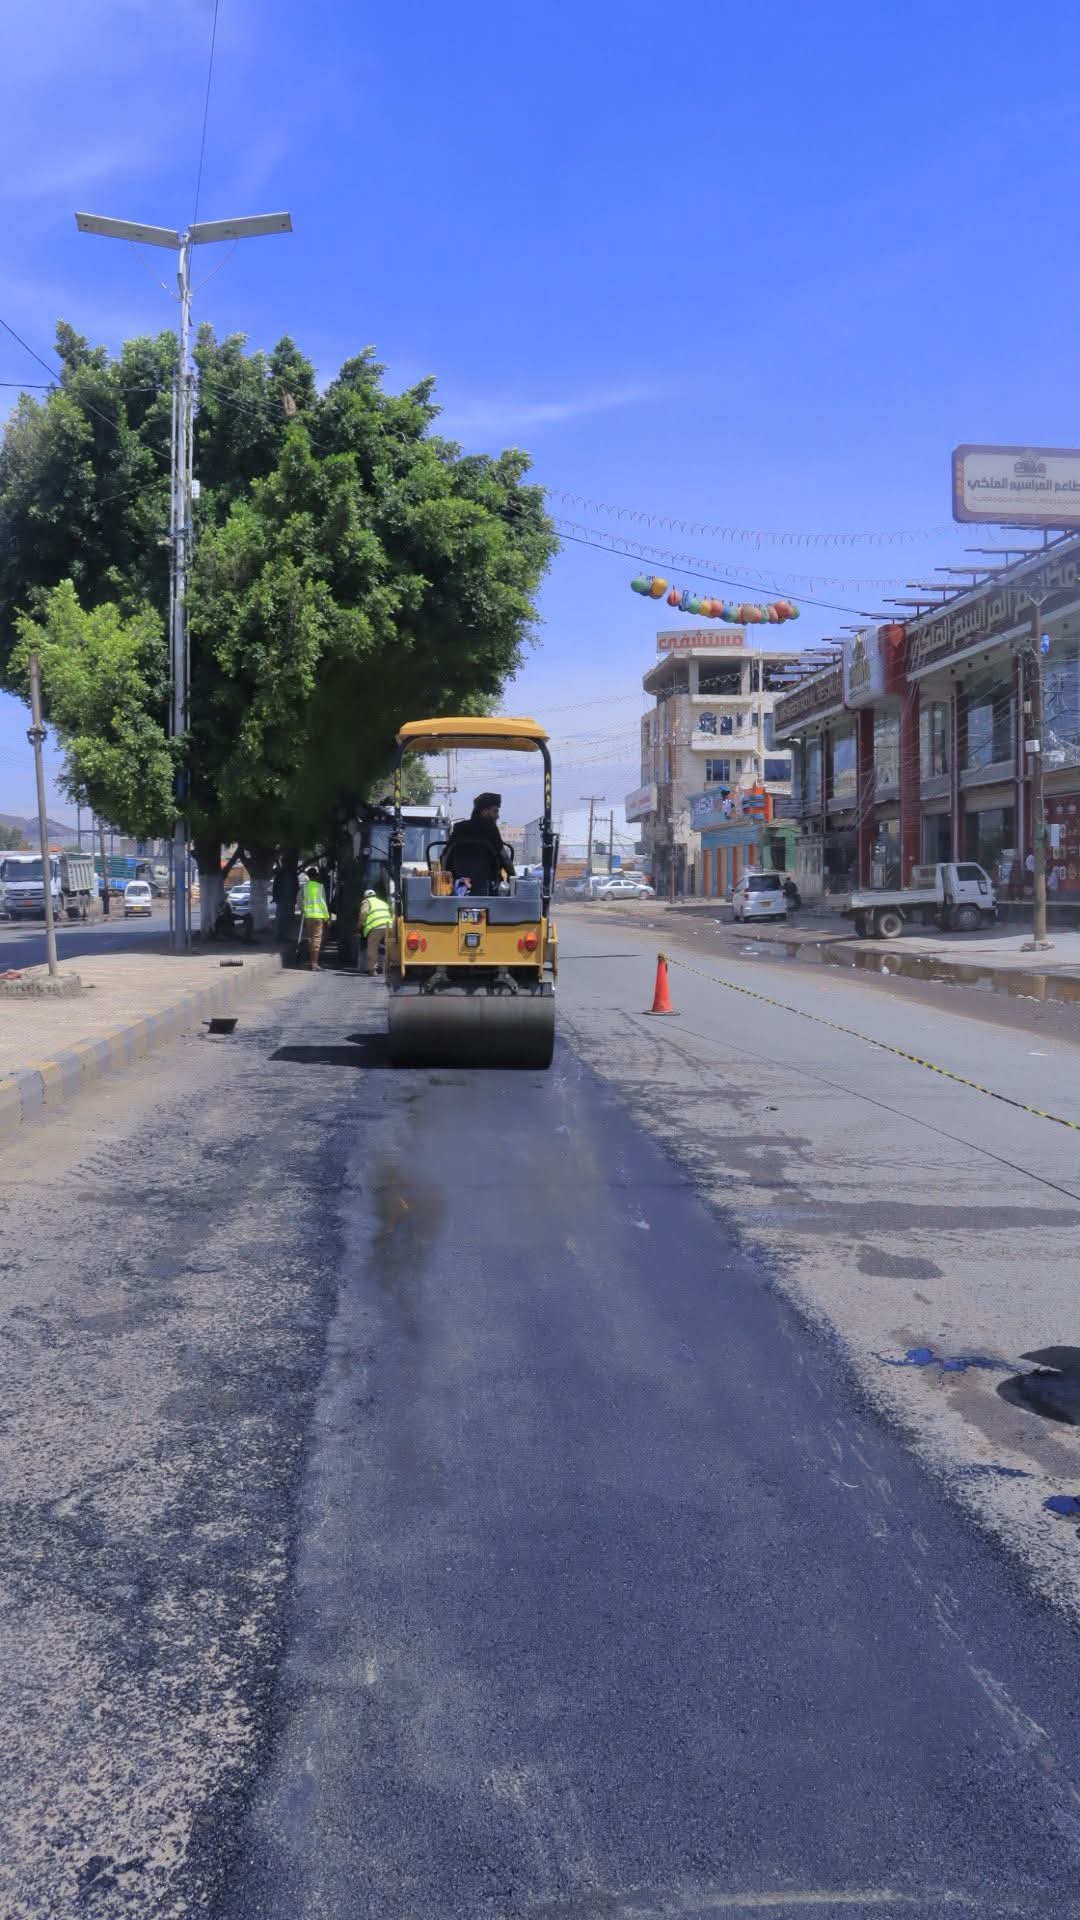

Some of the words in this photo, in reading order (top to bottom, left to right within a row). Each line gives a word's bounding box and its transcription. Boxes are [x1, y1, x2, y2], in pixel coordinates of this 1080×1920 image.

[967, 477, 1008, 491] الملكي
[1055, 480, 1080, 493] طاعم
[461, 911, 479, 922] CAT
